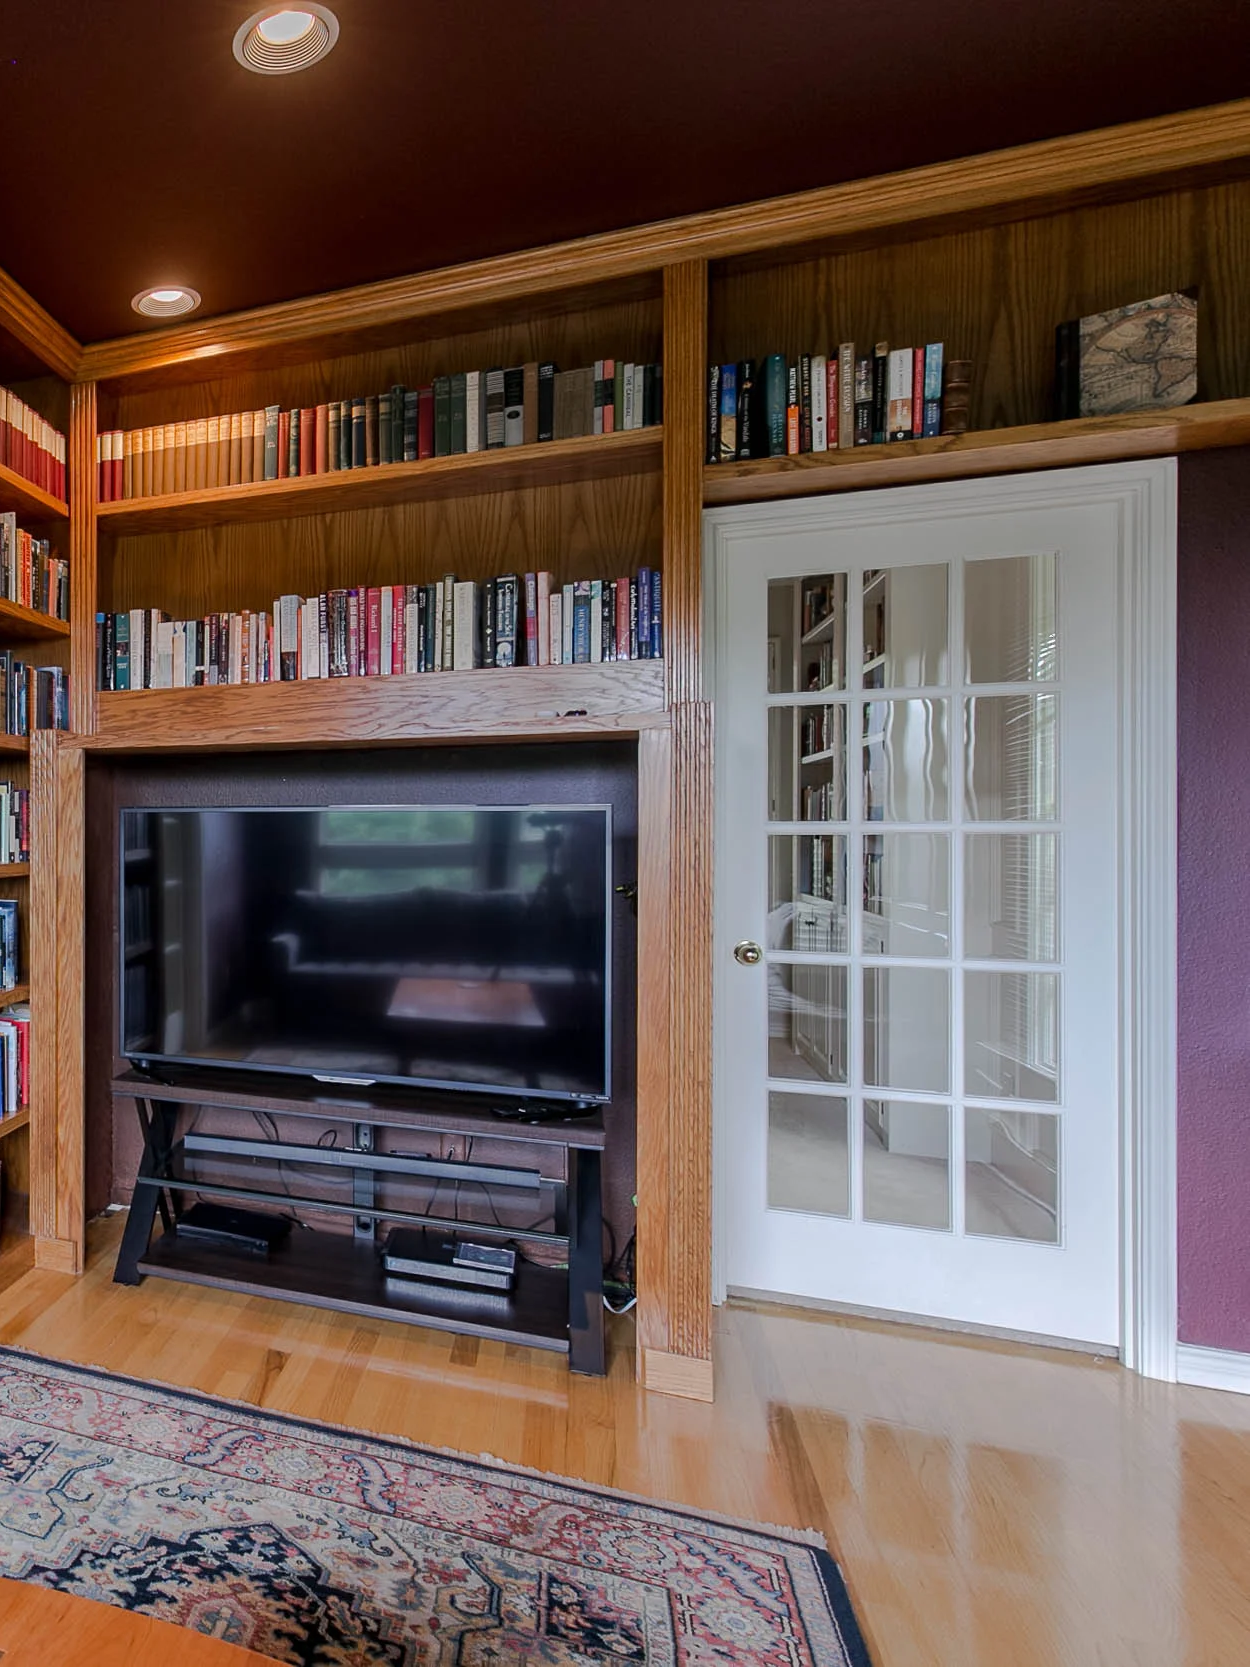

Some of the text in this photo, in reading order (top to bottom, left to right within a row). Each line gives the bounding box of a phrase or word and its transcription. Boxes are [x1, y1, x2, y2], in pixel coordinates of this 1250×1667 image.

[789, 367, 797, 389] MATTHEW
[319, 594, 327, 611] ALAN
[505, 583, 513, 612] CATHEDRAL
